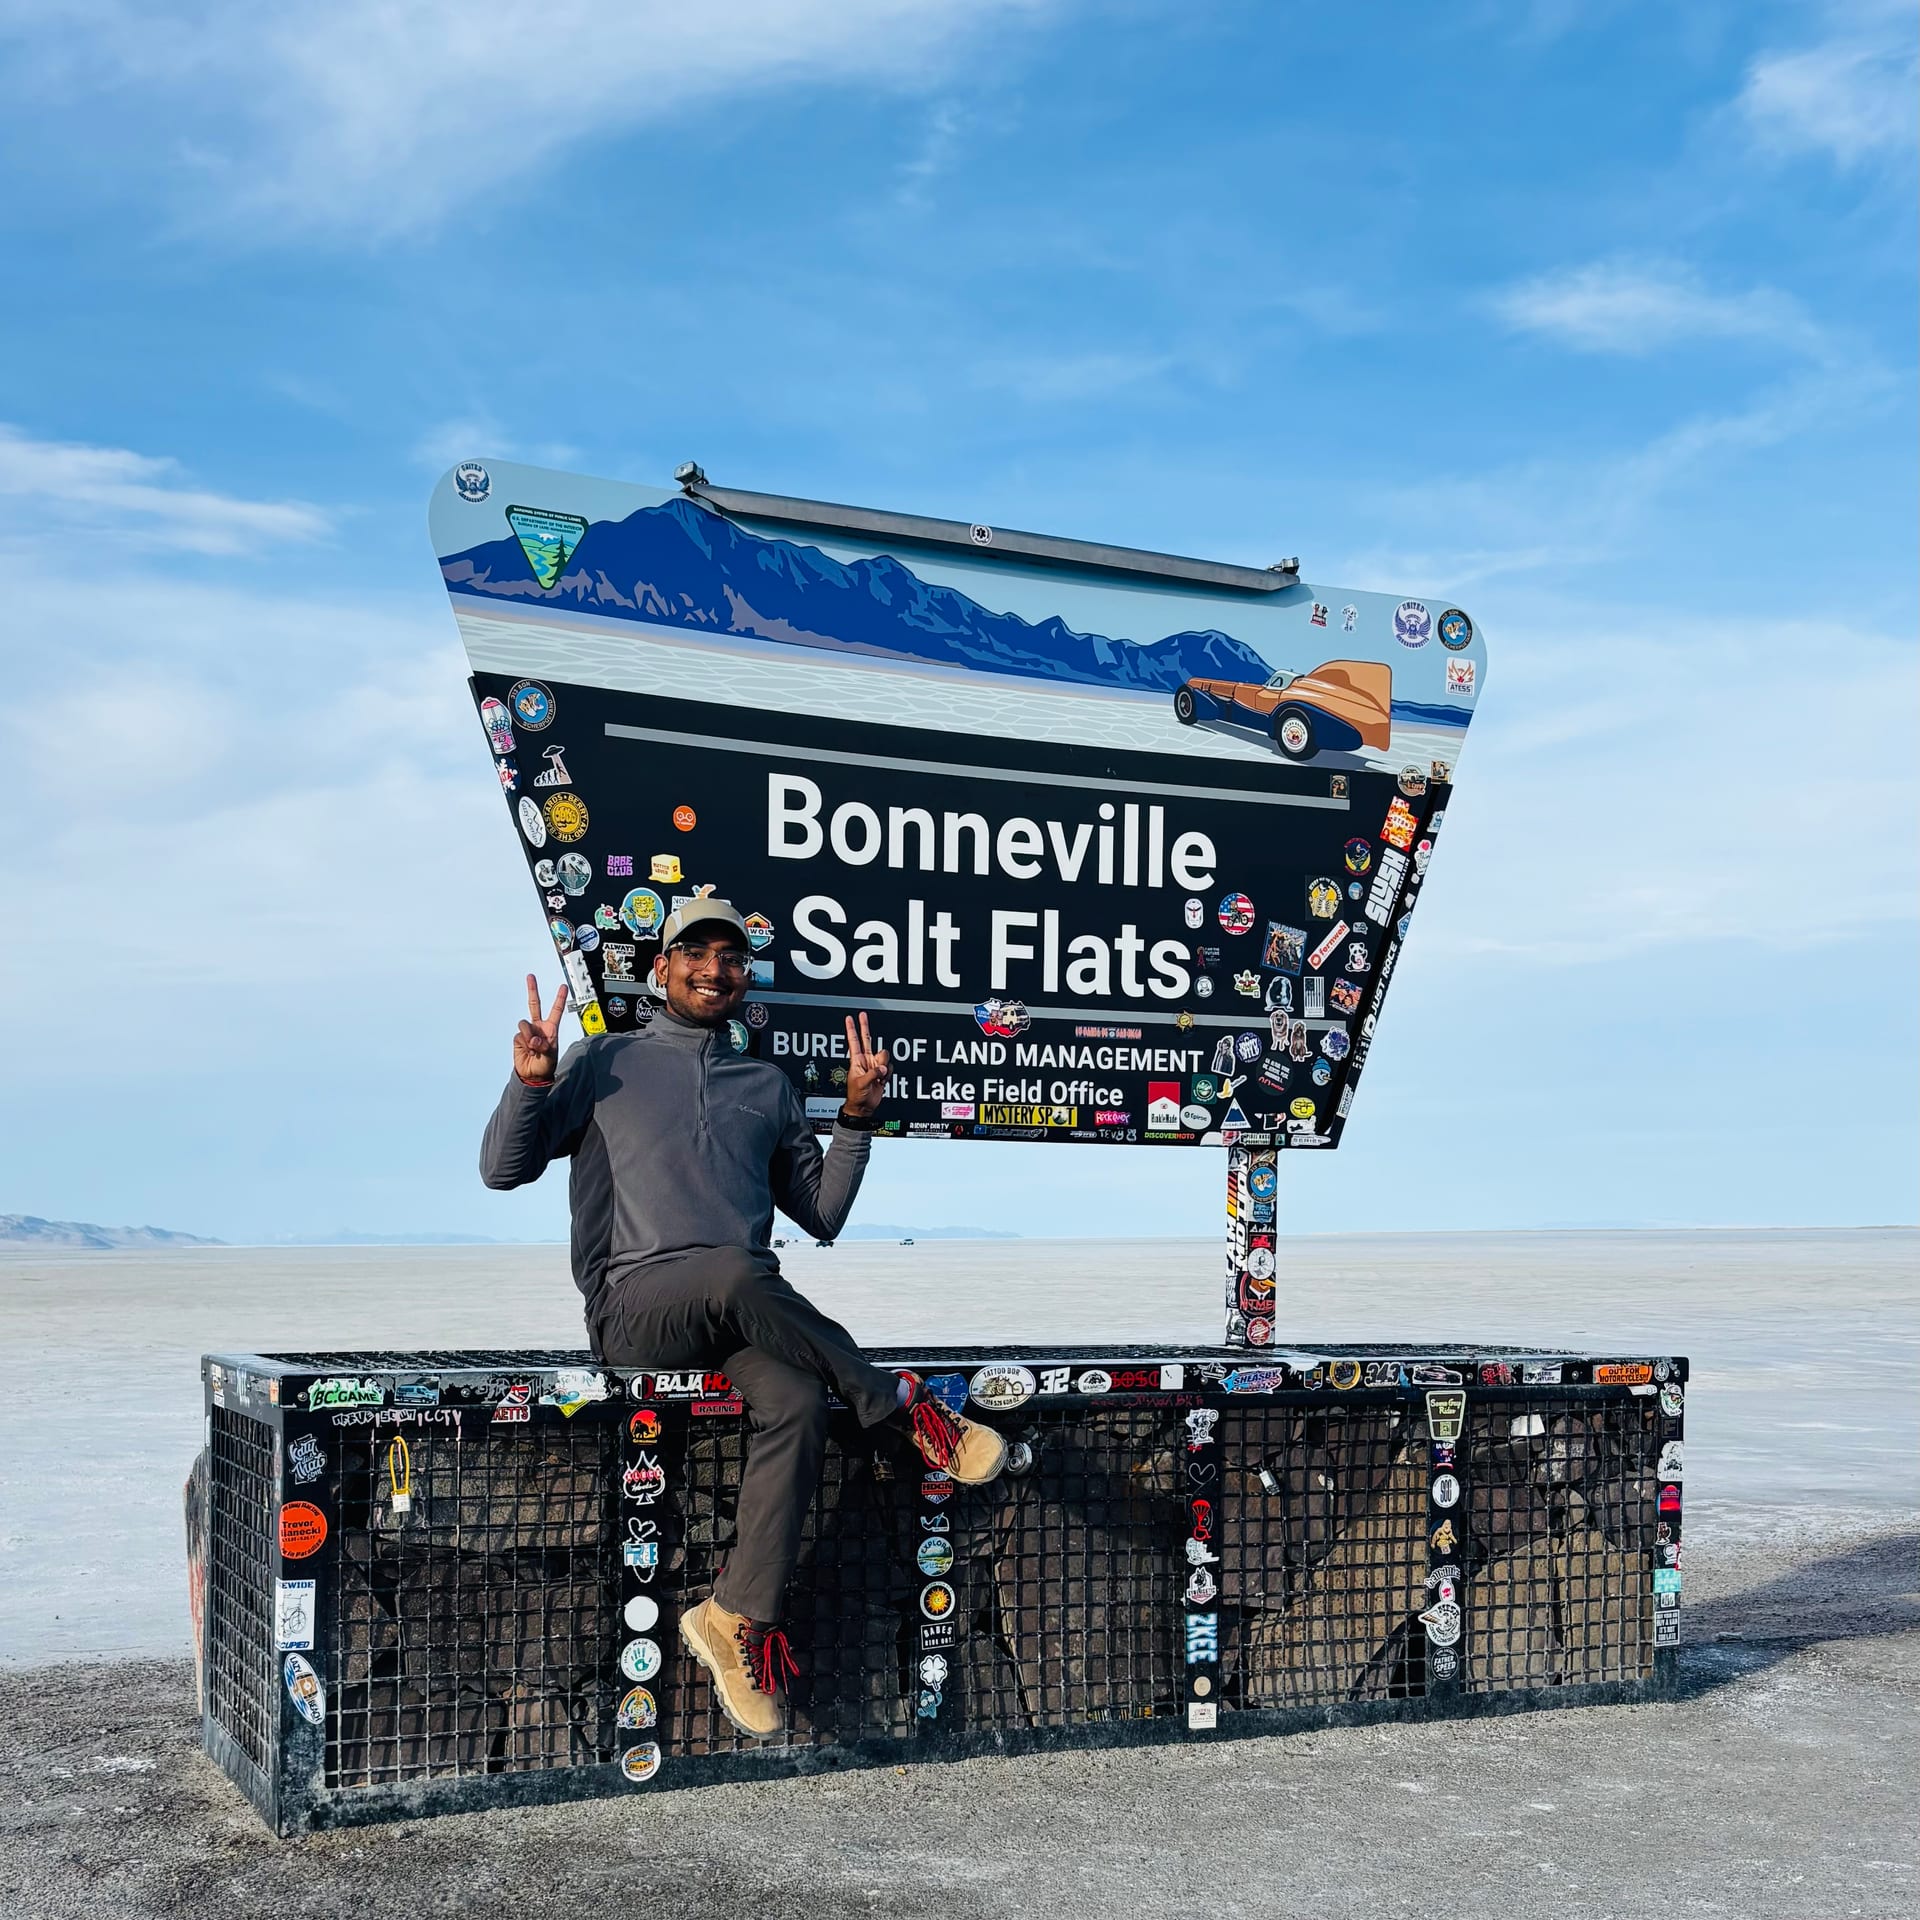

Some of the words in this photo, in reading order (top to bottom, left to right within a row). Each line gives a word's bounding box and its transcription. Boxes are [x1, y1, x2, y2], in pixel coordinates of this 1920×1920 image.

[1402, 601, 1425, 612] UNITED
[1450, 684, 1471, 693] ATESS
[768, 772, 1217, 892] Bonneville
[607, 855, 633, 866] BABE
[607, 866, 633, 876] CLUB
[1365, 848, 1407, 927] SLUSH
[790, 895, 961, 988] Salt
[991, 909, 1191, 999] Flats
[1319, 924, 1348, 957] fernweh
[604, 943, 635, 952] ALWAYS
[1382, 940, 1398, 979] RACE
[1371, 978, 1386, 1013] JUST
[773, 1031, 883, 1059] BURE
[892, 1037, 928, 1062] OF
[936, 1040, 1007, 1066] LAND
[1015, 1043, 1204, 1073] MANAGEMENT
[882, 1074, 909, 1099] alt
[917, 1075, 976, 1101] Lake
[983, 1078, 1042, 1103] Field
[1049, 1080, 1124, 1106] Office
[984, 1105, 1036, 1123] MYSTERY
[909, 1122, 929, 1130] RIDIN'
[930, 1122, 950, 1130] DIRTY
[1144, 1132, 1195, 1140] DISCOVERMOTO
[983, 1367, 1006, 1378] TATTOO
[1366, 1363, 1400, 1382] 343
[1039, 1367, 1070, 1394] 32
[314, 1388, 380, 1407] BC.GAME
[1431, 1399, 1447, 1407] Some
[1448, 1398, 1462, 1409] Guy
[699, 1404, 735, 1413] RACING
[1439, 1406, 1457, 1415] Rider
[425, 1408, 462, 1426] CCTV
[282, 1521, 314, 1529] Trevor
[921, 1540, 950, 1554] EXPLORE
[279, 1581, 314, 1590] EWIDE
[923, 1625, 953, 1638] BABES
[279, 1641, 310, 1649] CUPIED
